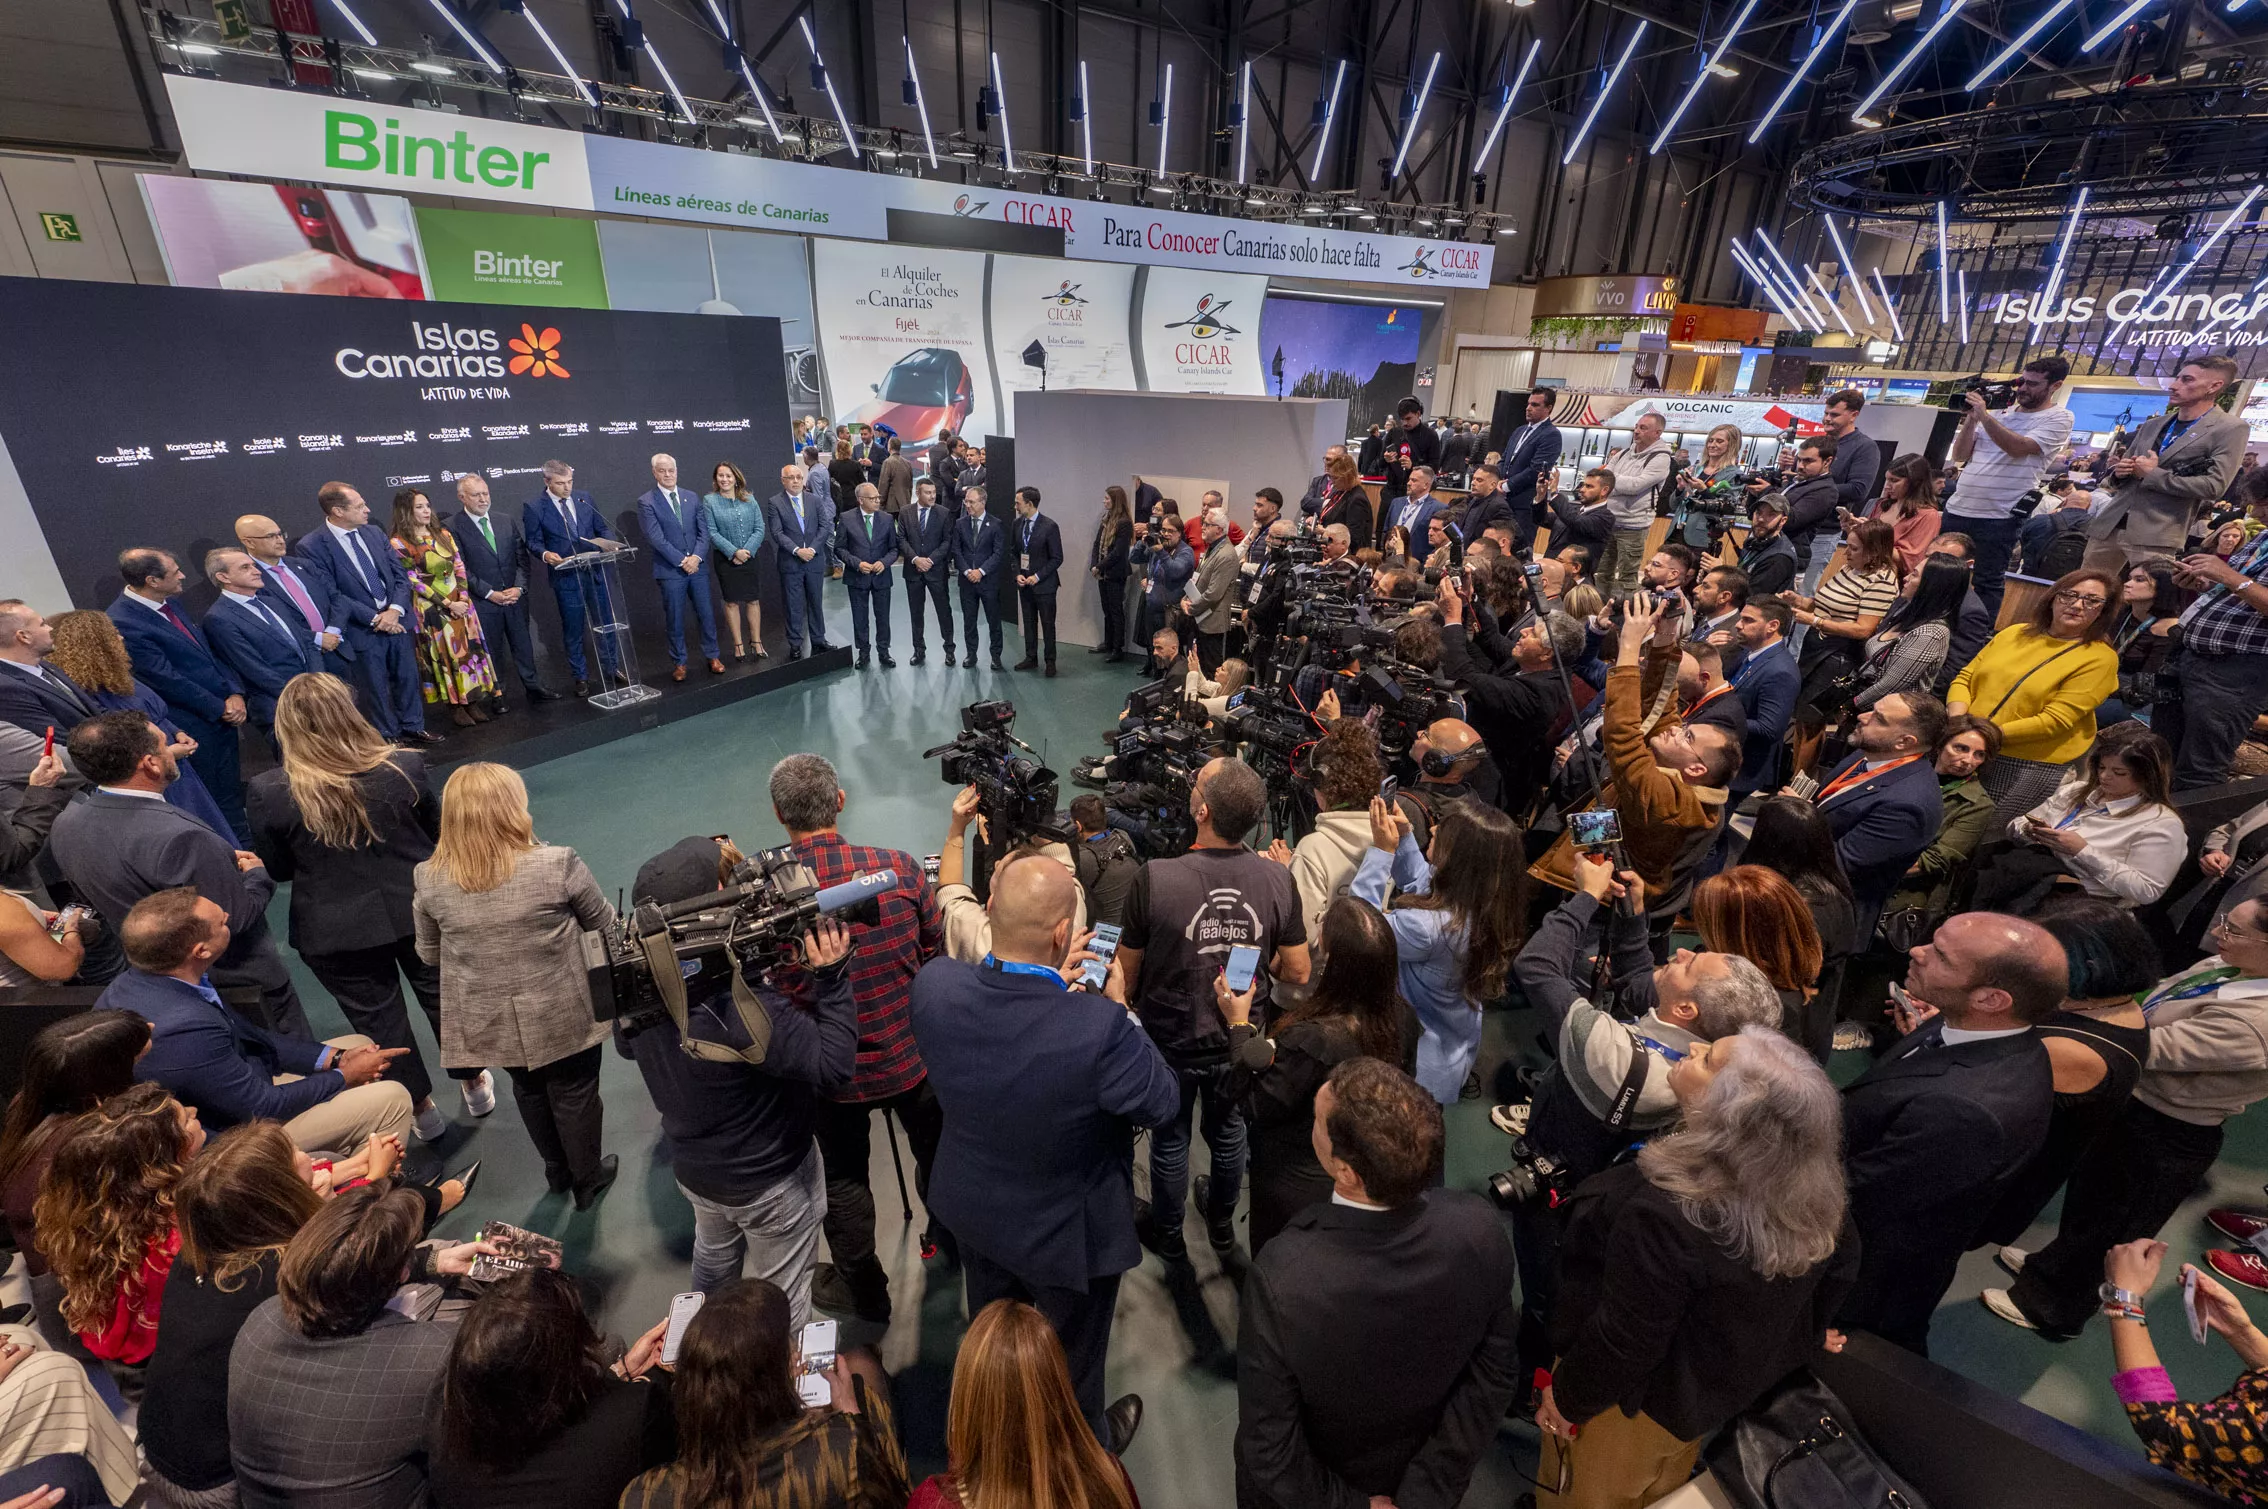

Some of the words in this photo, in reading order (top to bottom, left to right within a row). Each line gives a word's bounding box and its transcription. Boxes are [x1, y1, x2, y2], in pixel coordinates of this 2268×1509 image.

[325, 110, 549, 189] Binter
[614, 186, 671, 206] Líneas
[676, 194, 732, 213] aéreas
[737, 201, 757, 216] de
[762, 203, 829, 224] Canarias
[1004, 200, 1075, 233] CICAR
[1103, 217, 1142, 250] Para
[1147, 223, 1219, 254] Conocer
[1223, 229, 1286, 261] Canarias
[1290, 237, 1319, 263] solo
[1321, 238, 1351, 266] hace
[1354, 242, 1381, 268] falta
[474, 250, 563, 278] Binter
[1441, 247, 1480, 270] CICAR
[533, 278, 563, 286] Canarias
[881, 268, 889, 278] El
[893, 265, 942, 284] Alquiler
[1440, 269, 1455, 279] Canary
[868, 290, 933, 310] Canarias
[903, 285, 912, 295] de
[915, 283, 959, 298] Coches
[1047, 308, 1083, 321] CICAR
[412, 321, 500, 351] Islas
[2198, 331, 2220, 346] DE
[2225, 329, 2262, 347] VIDA
[335, 348, 506, 379] Canarias
[1175, 344, 1232, 365] CICAR
[1177, 367, 1199, 376] Canary
[1200, 367, 1221, 375] Islands
[470, 388, 484, 399] DE
[485, 387, 511, 400] VIDA
[1666, 402, 1734, 413] VOLCANIC
[298, 435, 328, 443] Canary
[1200, 924, 1248, 941] realejos
